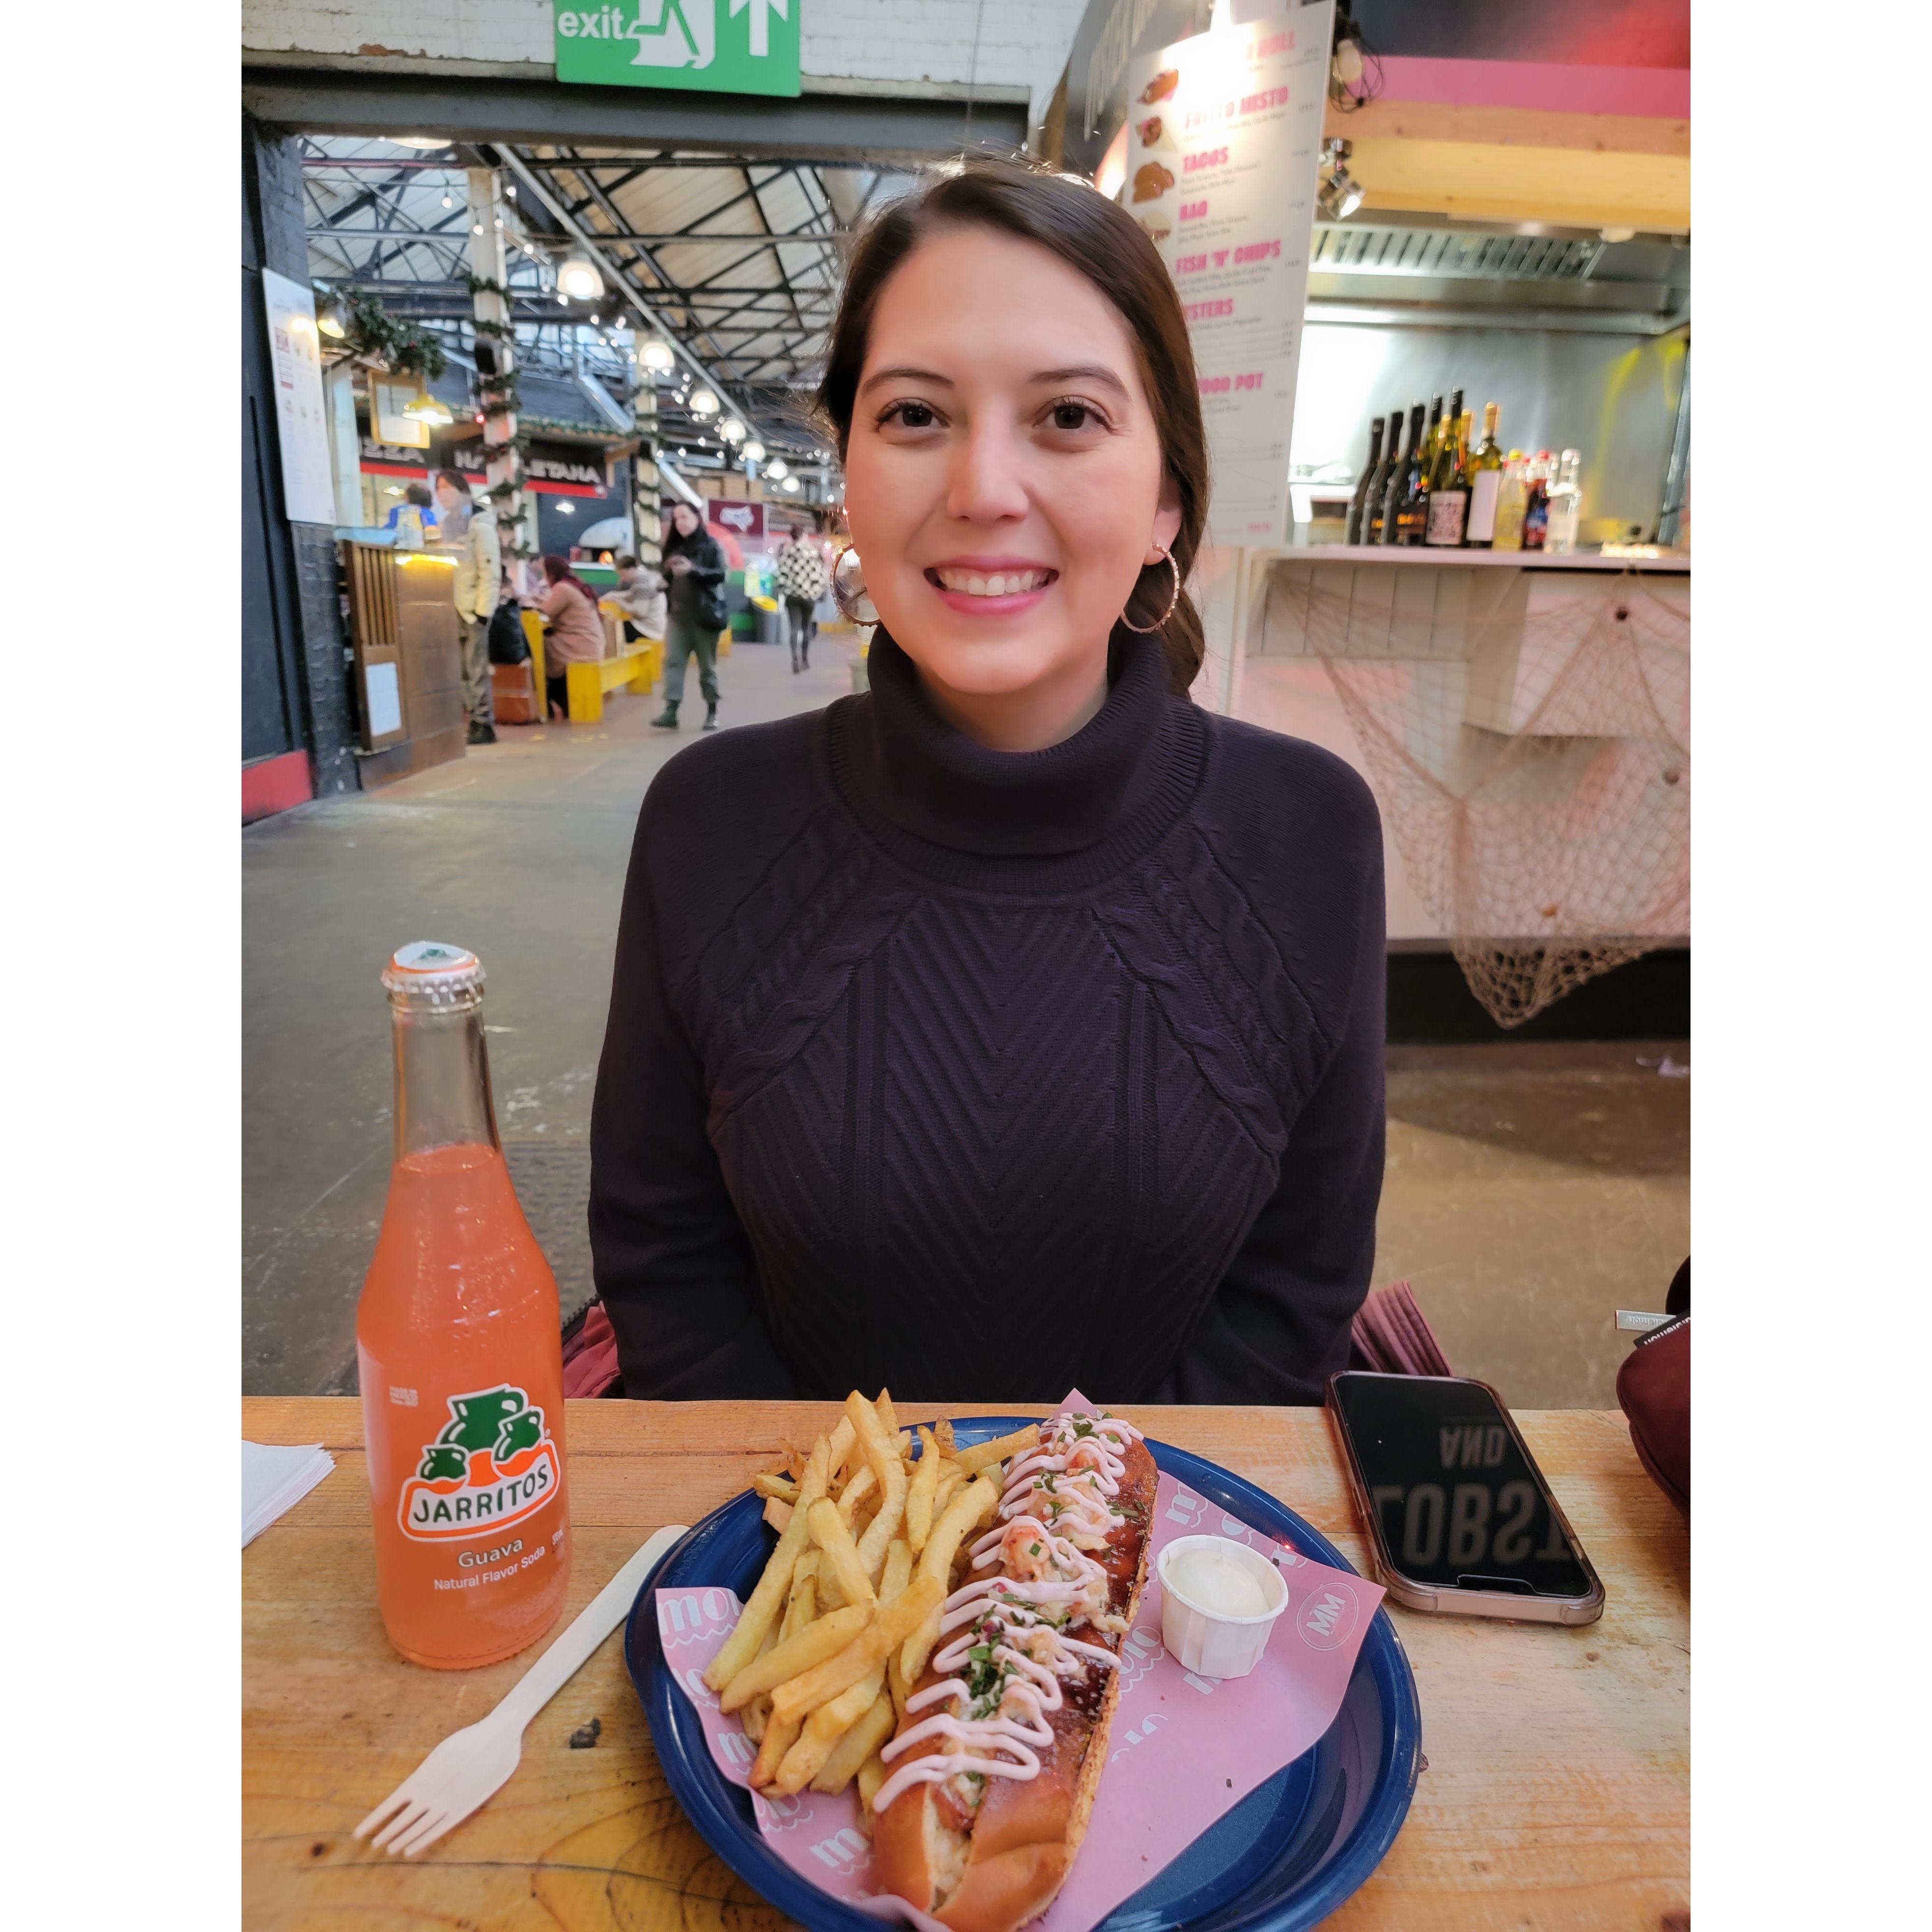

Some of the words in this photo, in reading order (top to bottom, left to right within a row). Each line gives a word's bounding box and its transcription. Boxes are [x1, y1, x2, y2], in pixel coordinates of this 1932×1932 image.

[558, 5, 624, 40] exit
[1239, 85, 1289, 114] MISTO
[1183, 146, 1228, 173] TACOS
[1176, 253, 1207, 274] FISH
[1233, 240, 1281, 264] CHIPS
[1235, 372, 1264, 392] POT
[413, 1463, 548, 1523] JARRITOS
[433, 1574, 479, 1591] Natural
[483, 1563, 518, 1585] Flavor
[521, 1546, 546, 1569] Soda
[458, 1538, 524, 1568] Guava
[1306, 1592, 1345, 1636] MM
